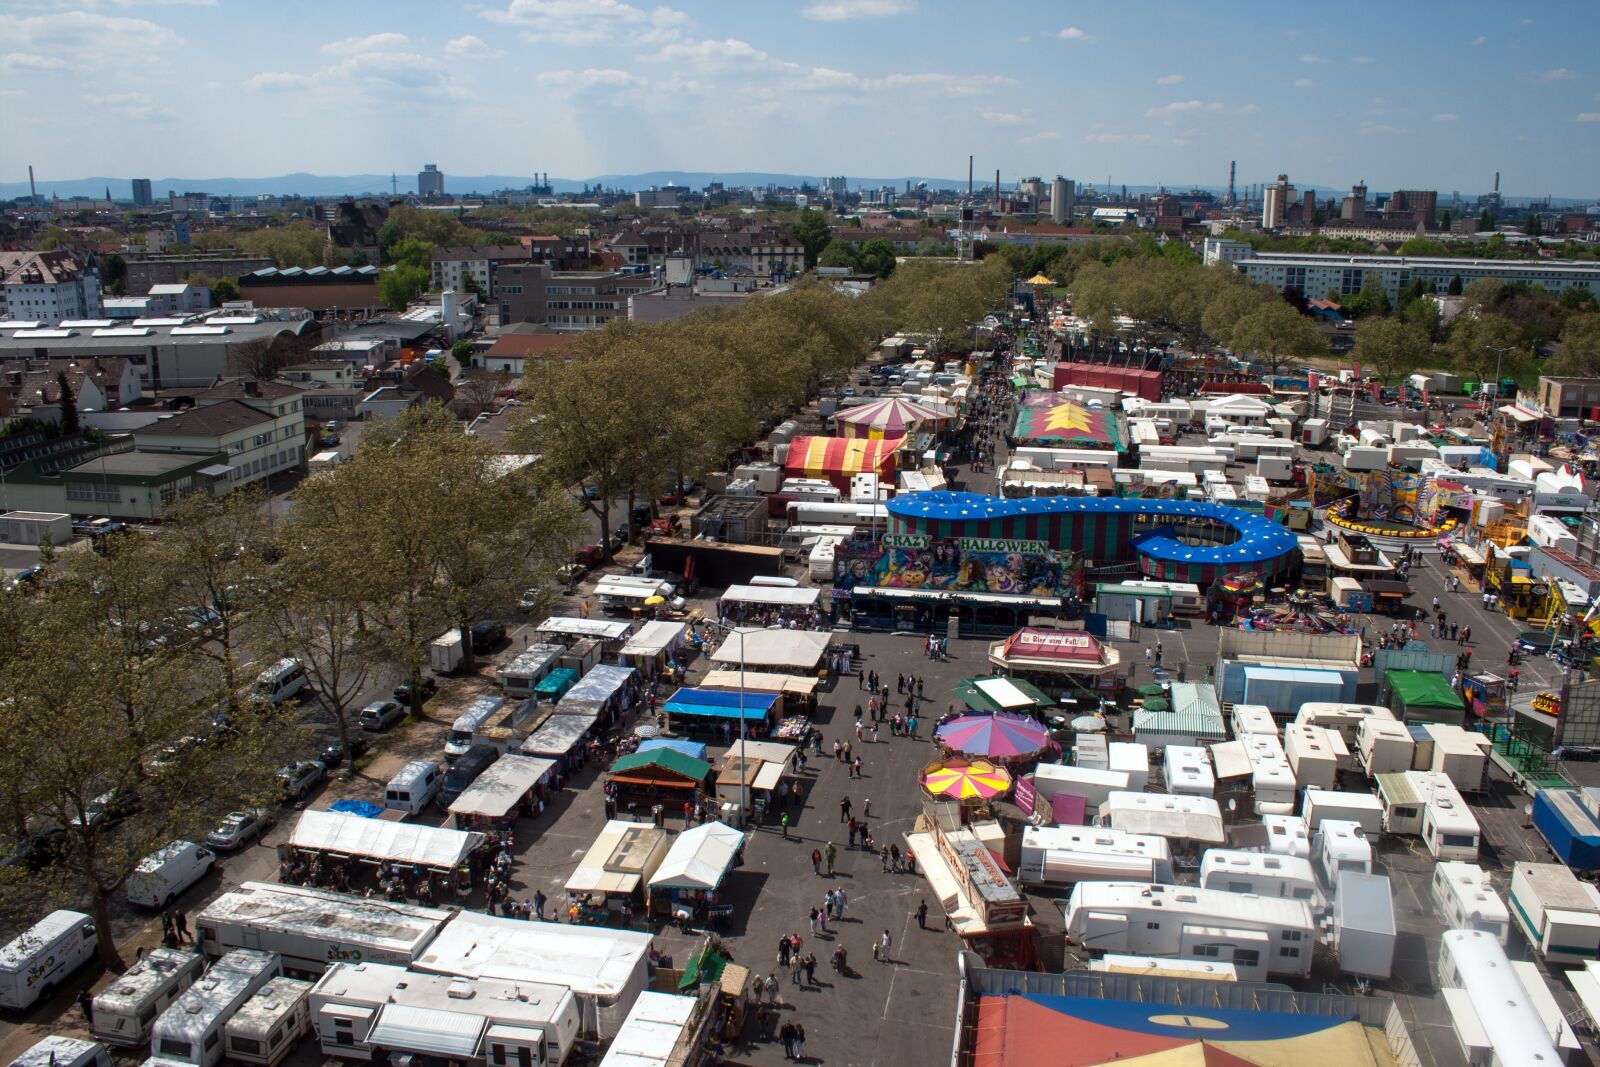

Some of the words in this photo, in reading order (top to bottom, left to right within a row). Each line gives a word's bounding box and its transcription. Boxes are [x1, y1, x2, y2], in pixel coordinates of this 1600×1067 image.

[883, 534, 930, 548] CRAZY
[960, 538, 1048, 554] HALLOWEEN
[1032, 635, 1046, 643] Bier
